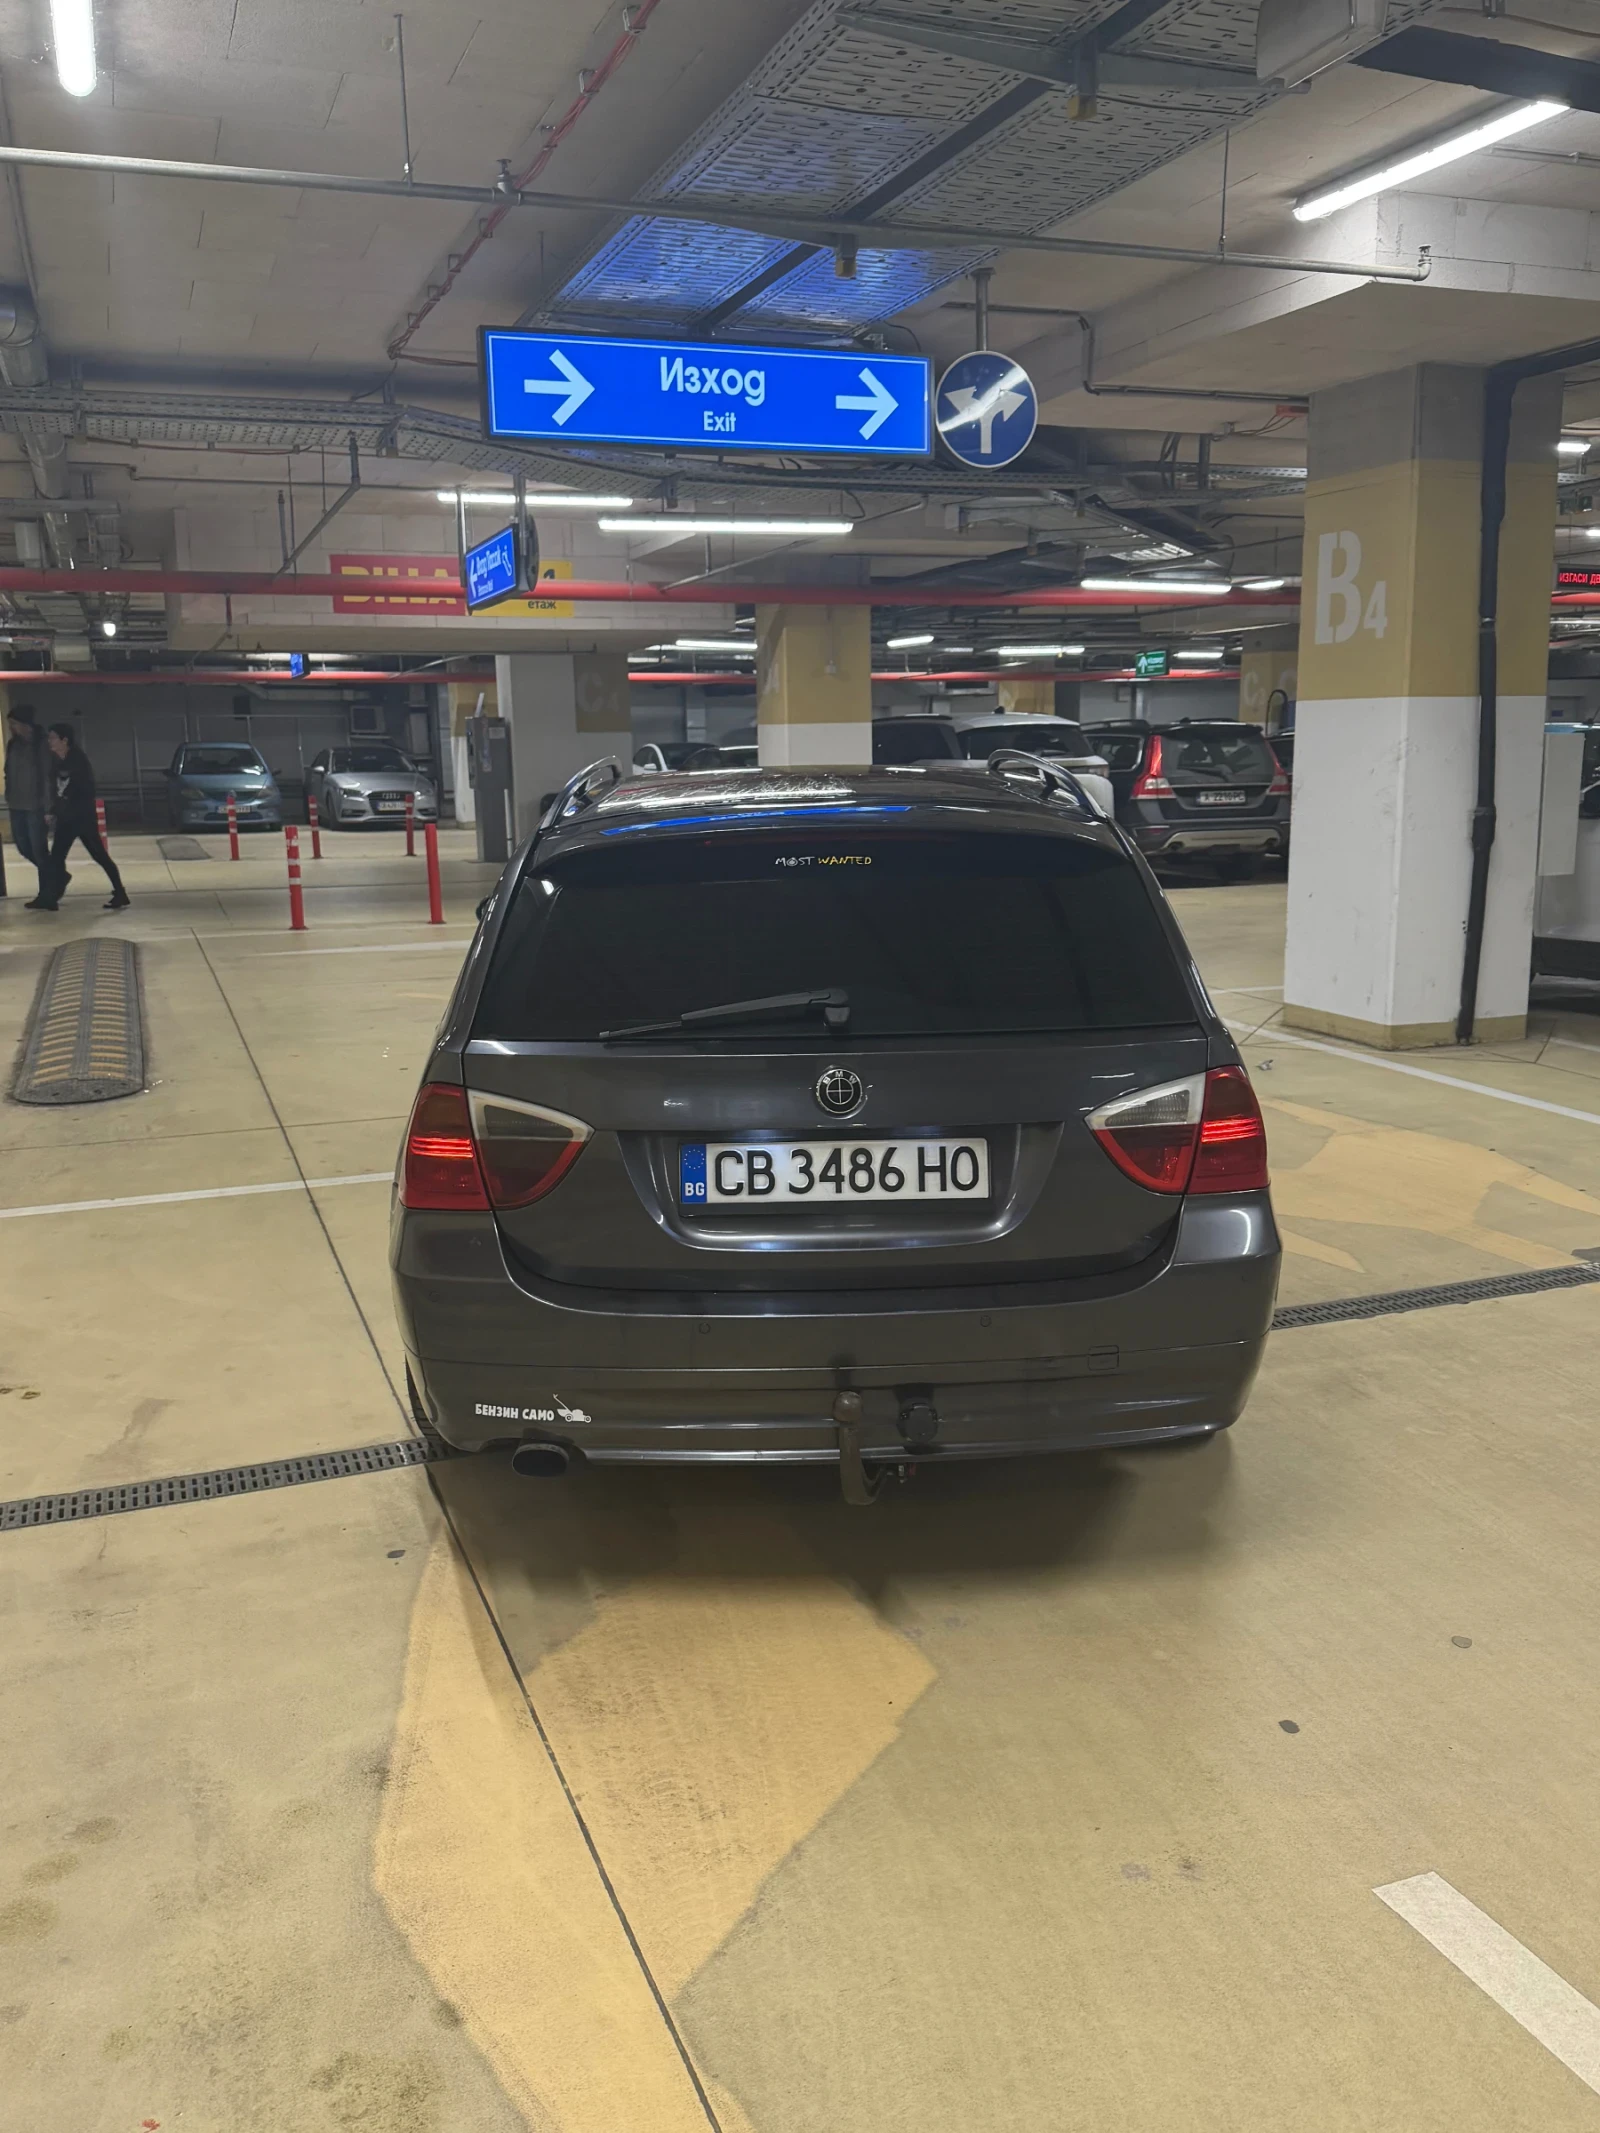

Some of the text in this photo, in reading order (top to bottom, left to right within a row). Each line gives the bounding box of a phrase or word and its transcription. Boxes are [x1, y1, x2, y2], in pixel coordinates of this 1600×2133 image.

[660, 357, 765, 405] Изход
[703, 411, 736, 433] Exit
[1559, 572, 1588, 584] ИЗГАСИ
[528, 600, 557, 609] етаж
[817, 855, 872, 866] WANTED
[822, 1070, 857, 1085] BMW
[715, 1146, 980, 1196] CB 3486 HO
[684, 1182, 705, 1197] BG
[475, 1403, 555, 1421] БЕНЗИН САМО
